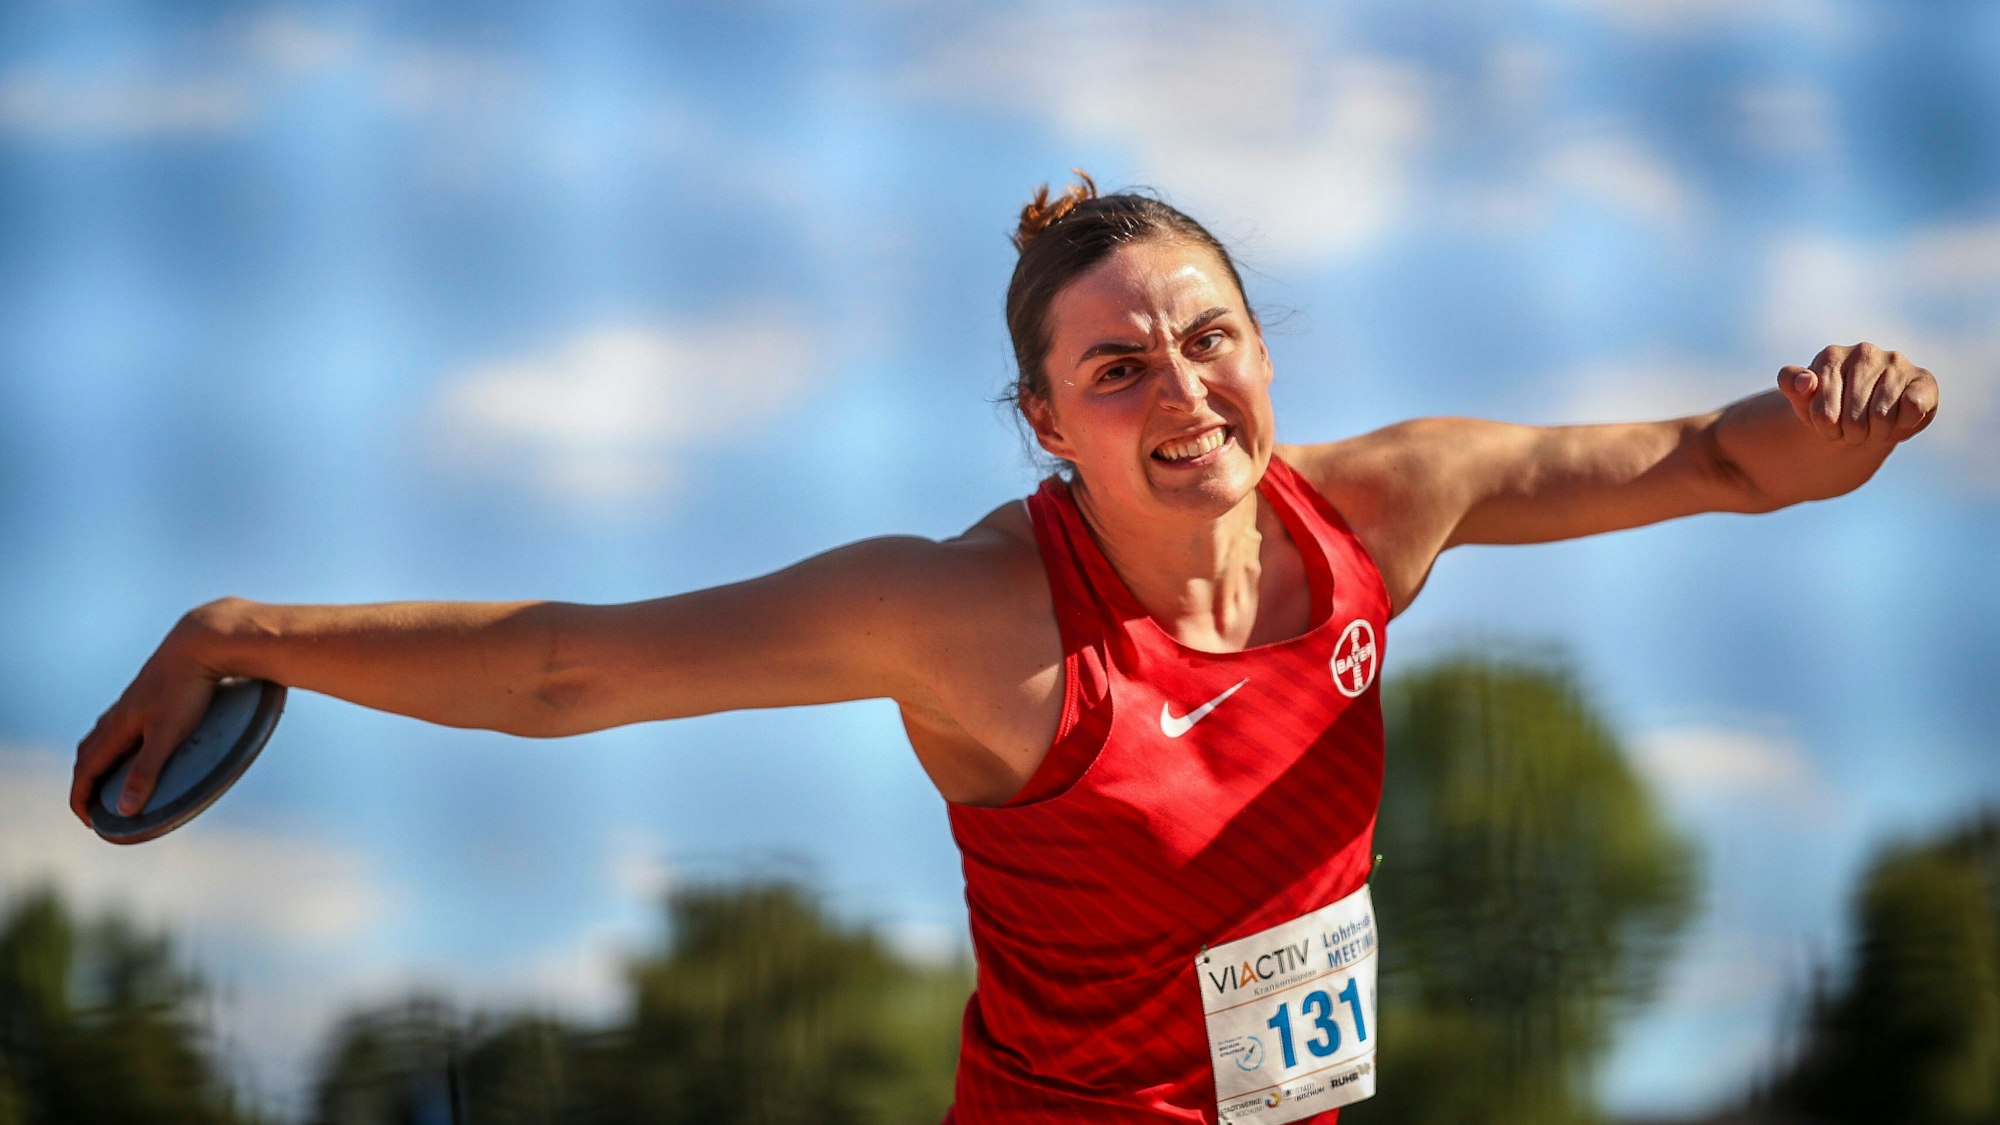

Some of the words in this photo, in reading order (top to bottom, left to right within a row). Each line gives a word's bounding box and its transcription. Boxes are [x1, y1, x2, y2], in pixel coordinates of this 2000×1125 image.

[1336, 642, 1373, 675] BAYER
[1209, 938, 1309, 994] VIACTIV
[1267, 976, 1367, 1069] 131
[1331, 1072, 1359, 1088] RUHR
